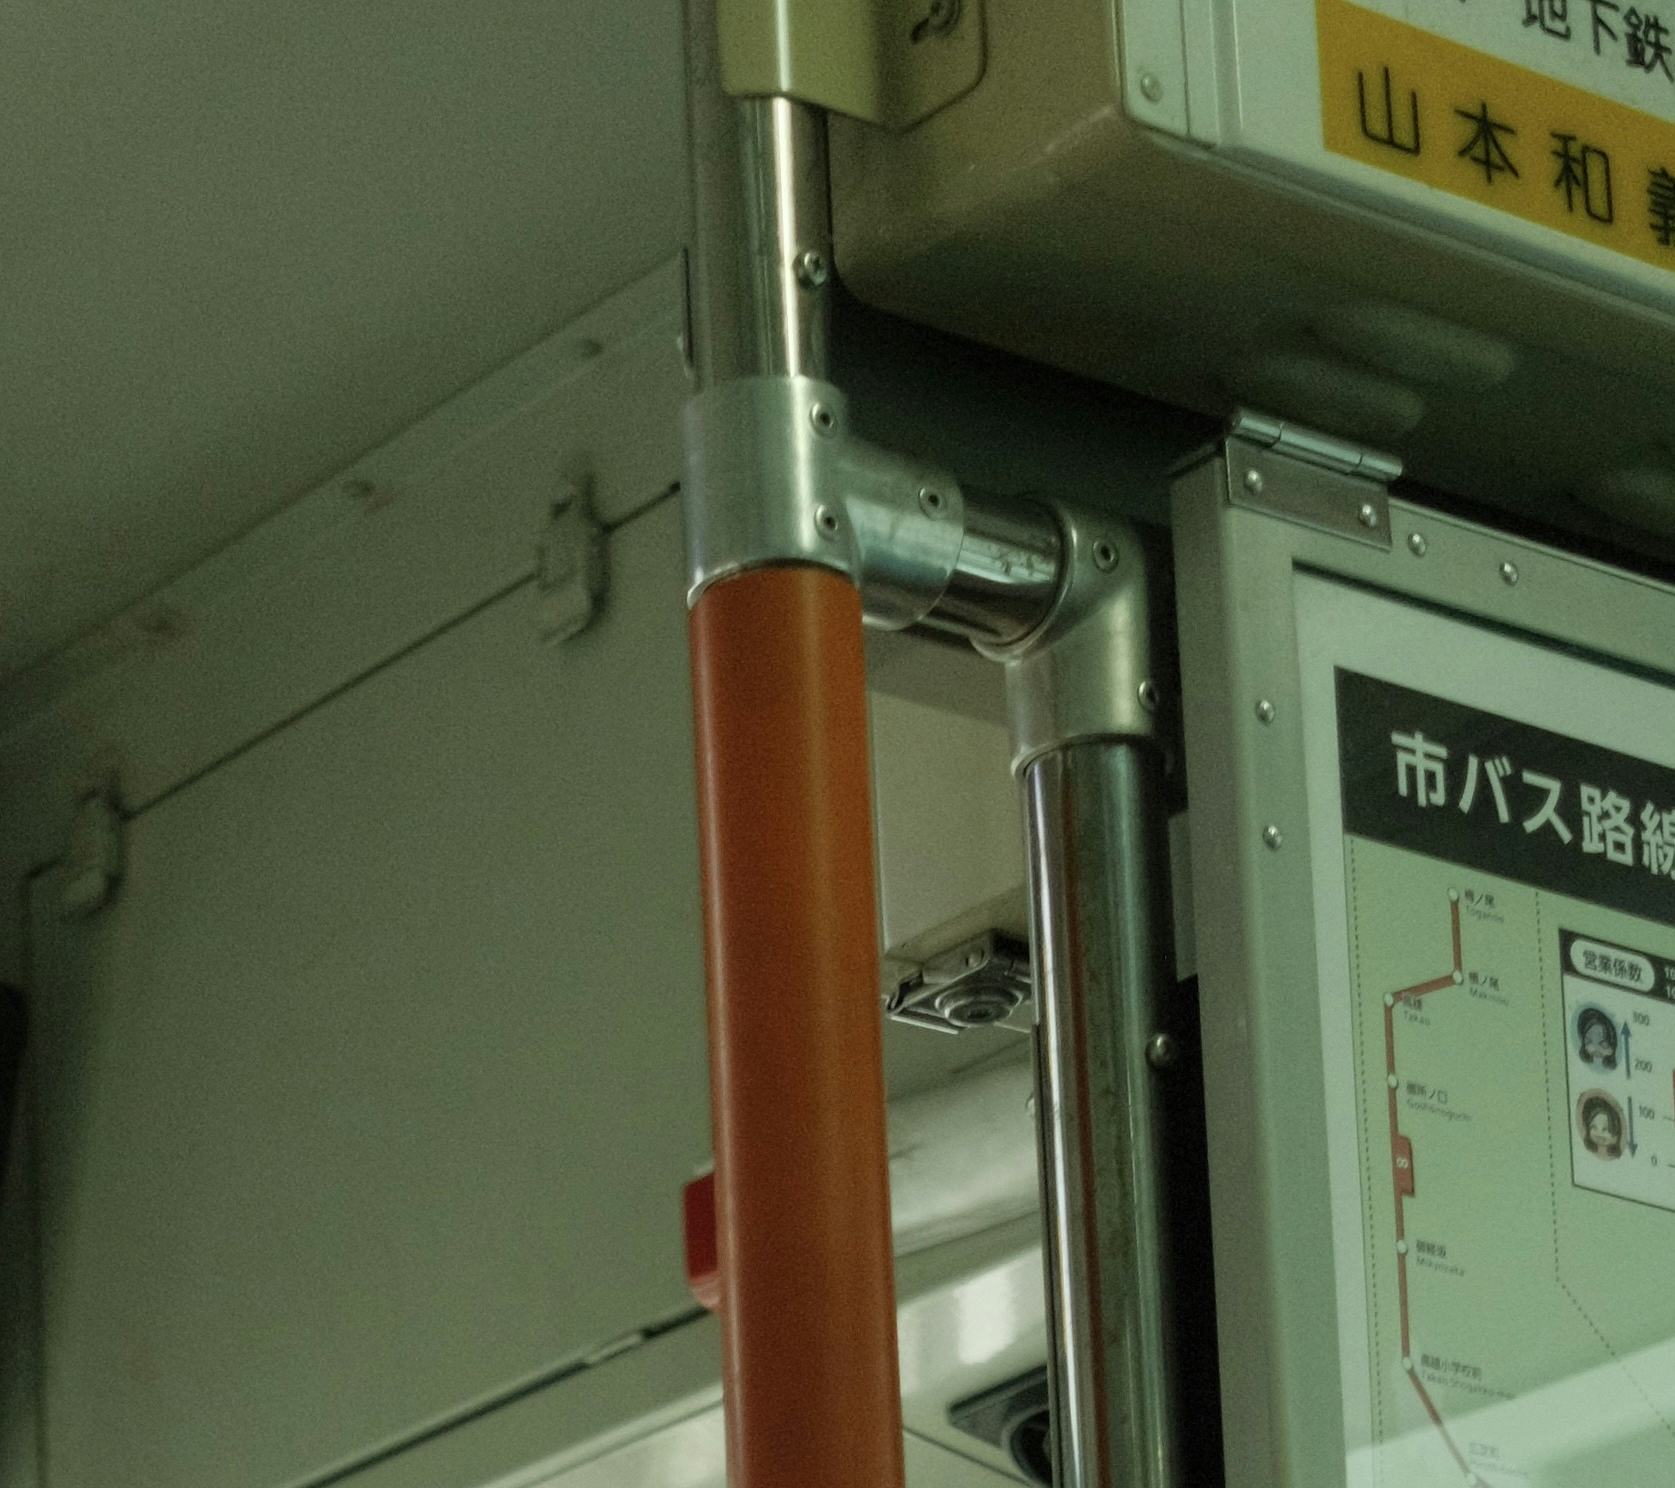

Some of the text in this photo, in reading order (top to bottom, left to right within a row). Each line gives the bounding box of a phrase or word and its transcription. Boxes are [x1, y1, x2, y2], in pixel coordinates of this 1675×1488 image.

[1582, 949, 1644, 983] 営業係数
[1634, 1059, 1653, 1074] 200
[1638, 1105, 1656, 1120] 100
